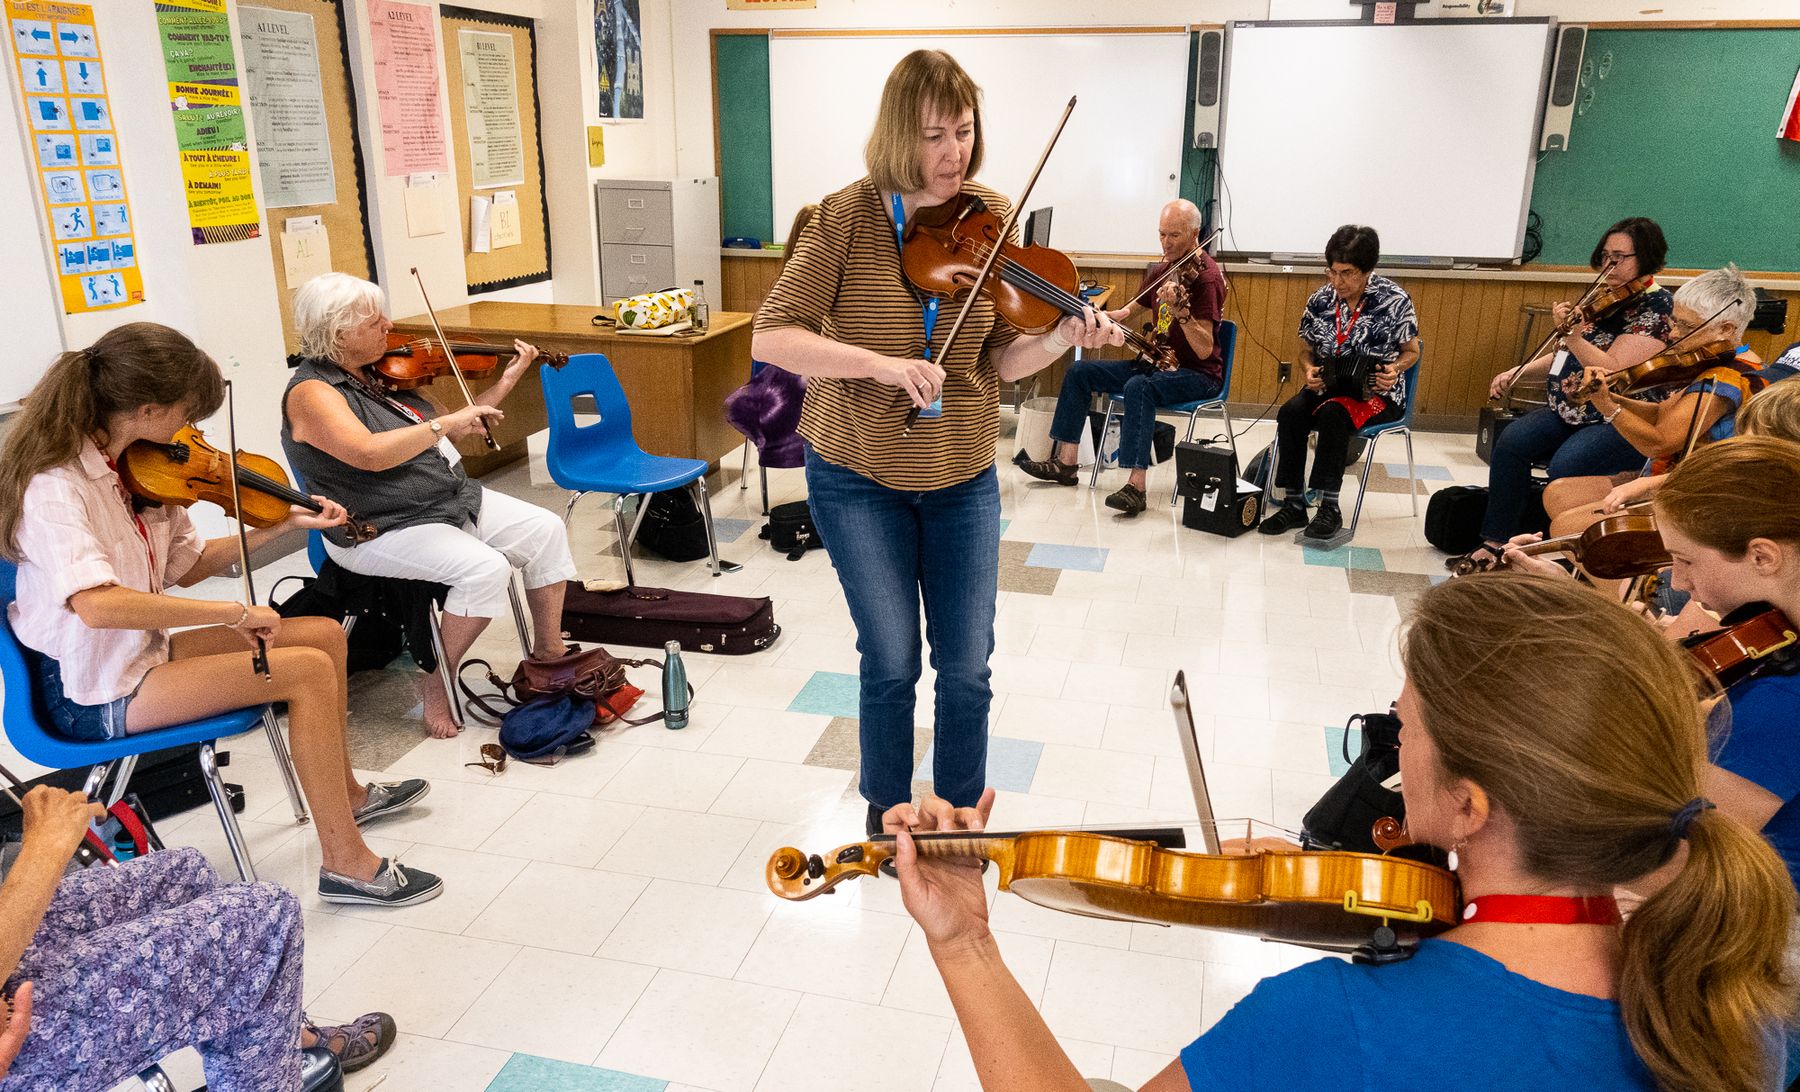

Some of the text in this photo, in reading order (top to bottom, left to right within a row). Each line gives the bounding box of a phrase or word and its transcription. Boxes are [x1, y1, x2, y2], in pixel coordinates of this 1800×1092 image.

[387, 11, 414, 22] A2 LEVEL
[257, 22, 290, 35] A1 LEVEL
[168, 32, 200, 41] COMMENT
[176, 85, 199, 95] BONNE
[200, 87, 230, 98] JOURNÉE
[178, 113, 200, 122] SALUT
[207, 113, 215, 121] AU
[197, 127, 216, 135] ADIEU
[188, 154, 206, 162] TOUT
[212, 154, 237, 162] L'HEURE
[188, 180, 193, 189] À
